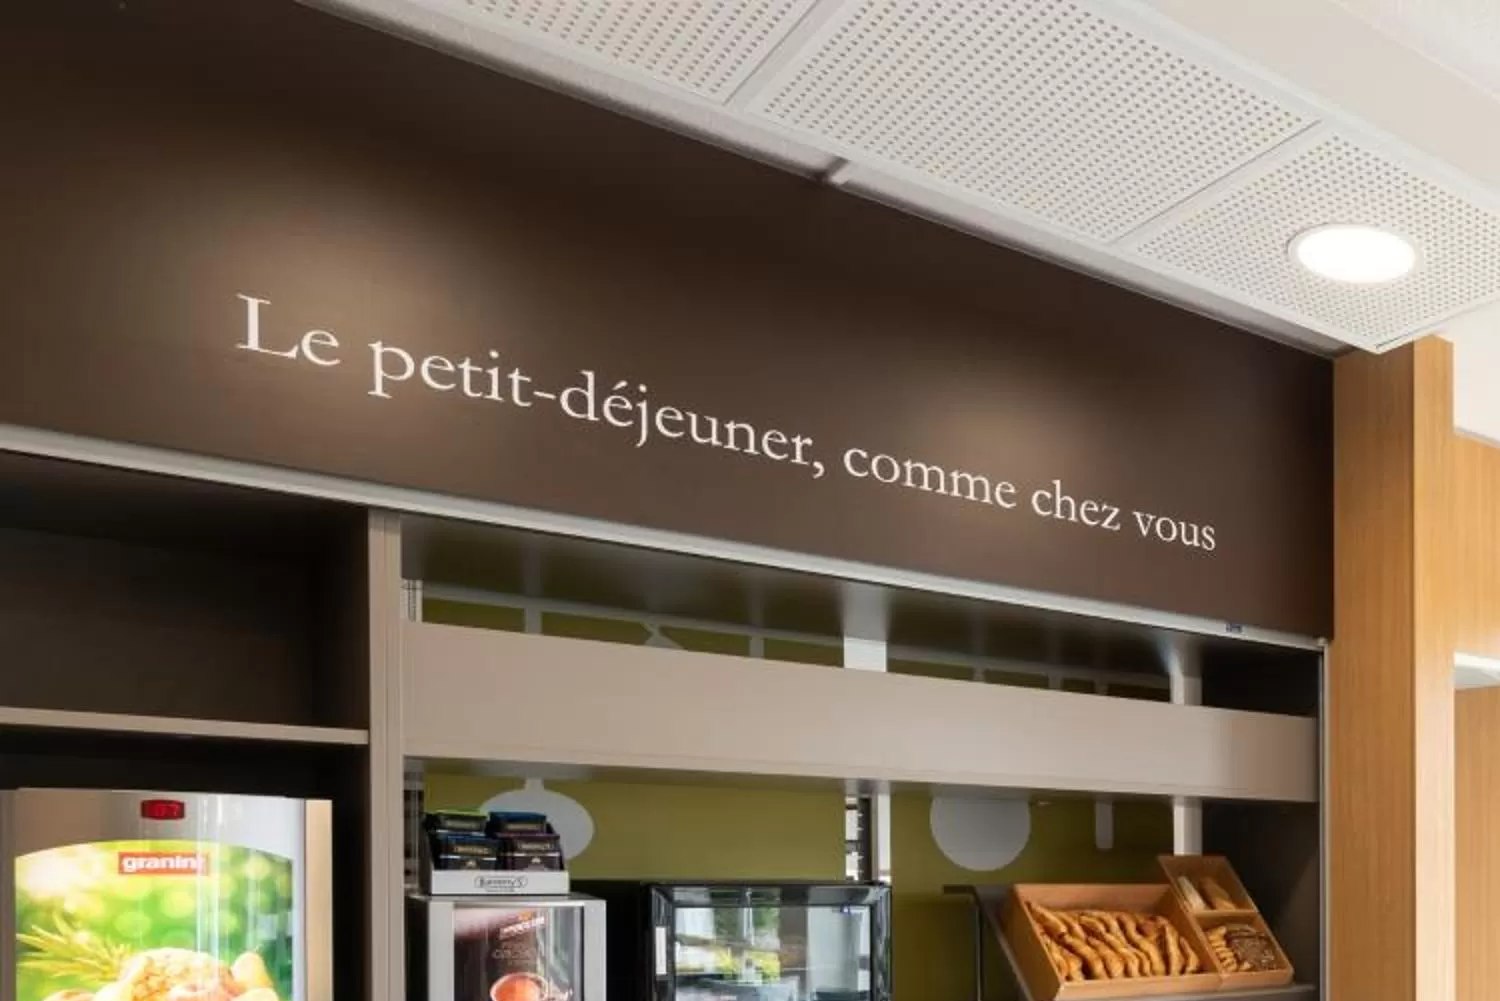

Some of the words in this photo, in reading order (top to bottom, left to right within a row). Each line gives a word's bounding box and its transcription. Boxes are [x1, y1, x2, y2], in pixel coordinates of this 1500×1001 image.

[237, 294, 341, 366] Le
[367, 340, 825, 479] petit-déjeuner,
[843, 447, 1017, 509] comme
[1031, 479, 1121, 531] chez
[1132, 511, 1216, 551] vous
